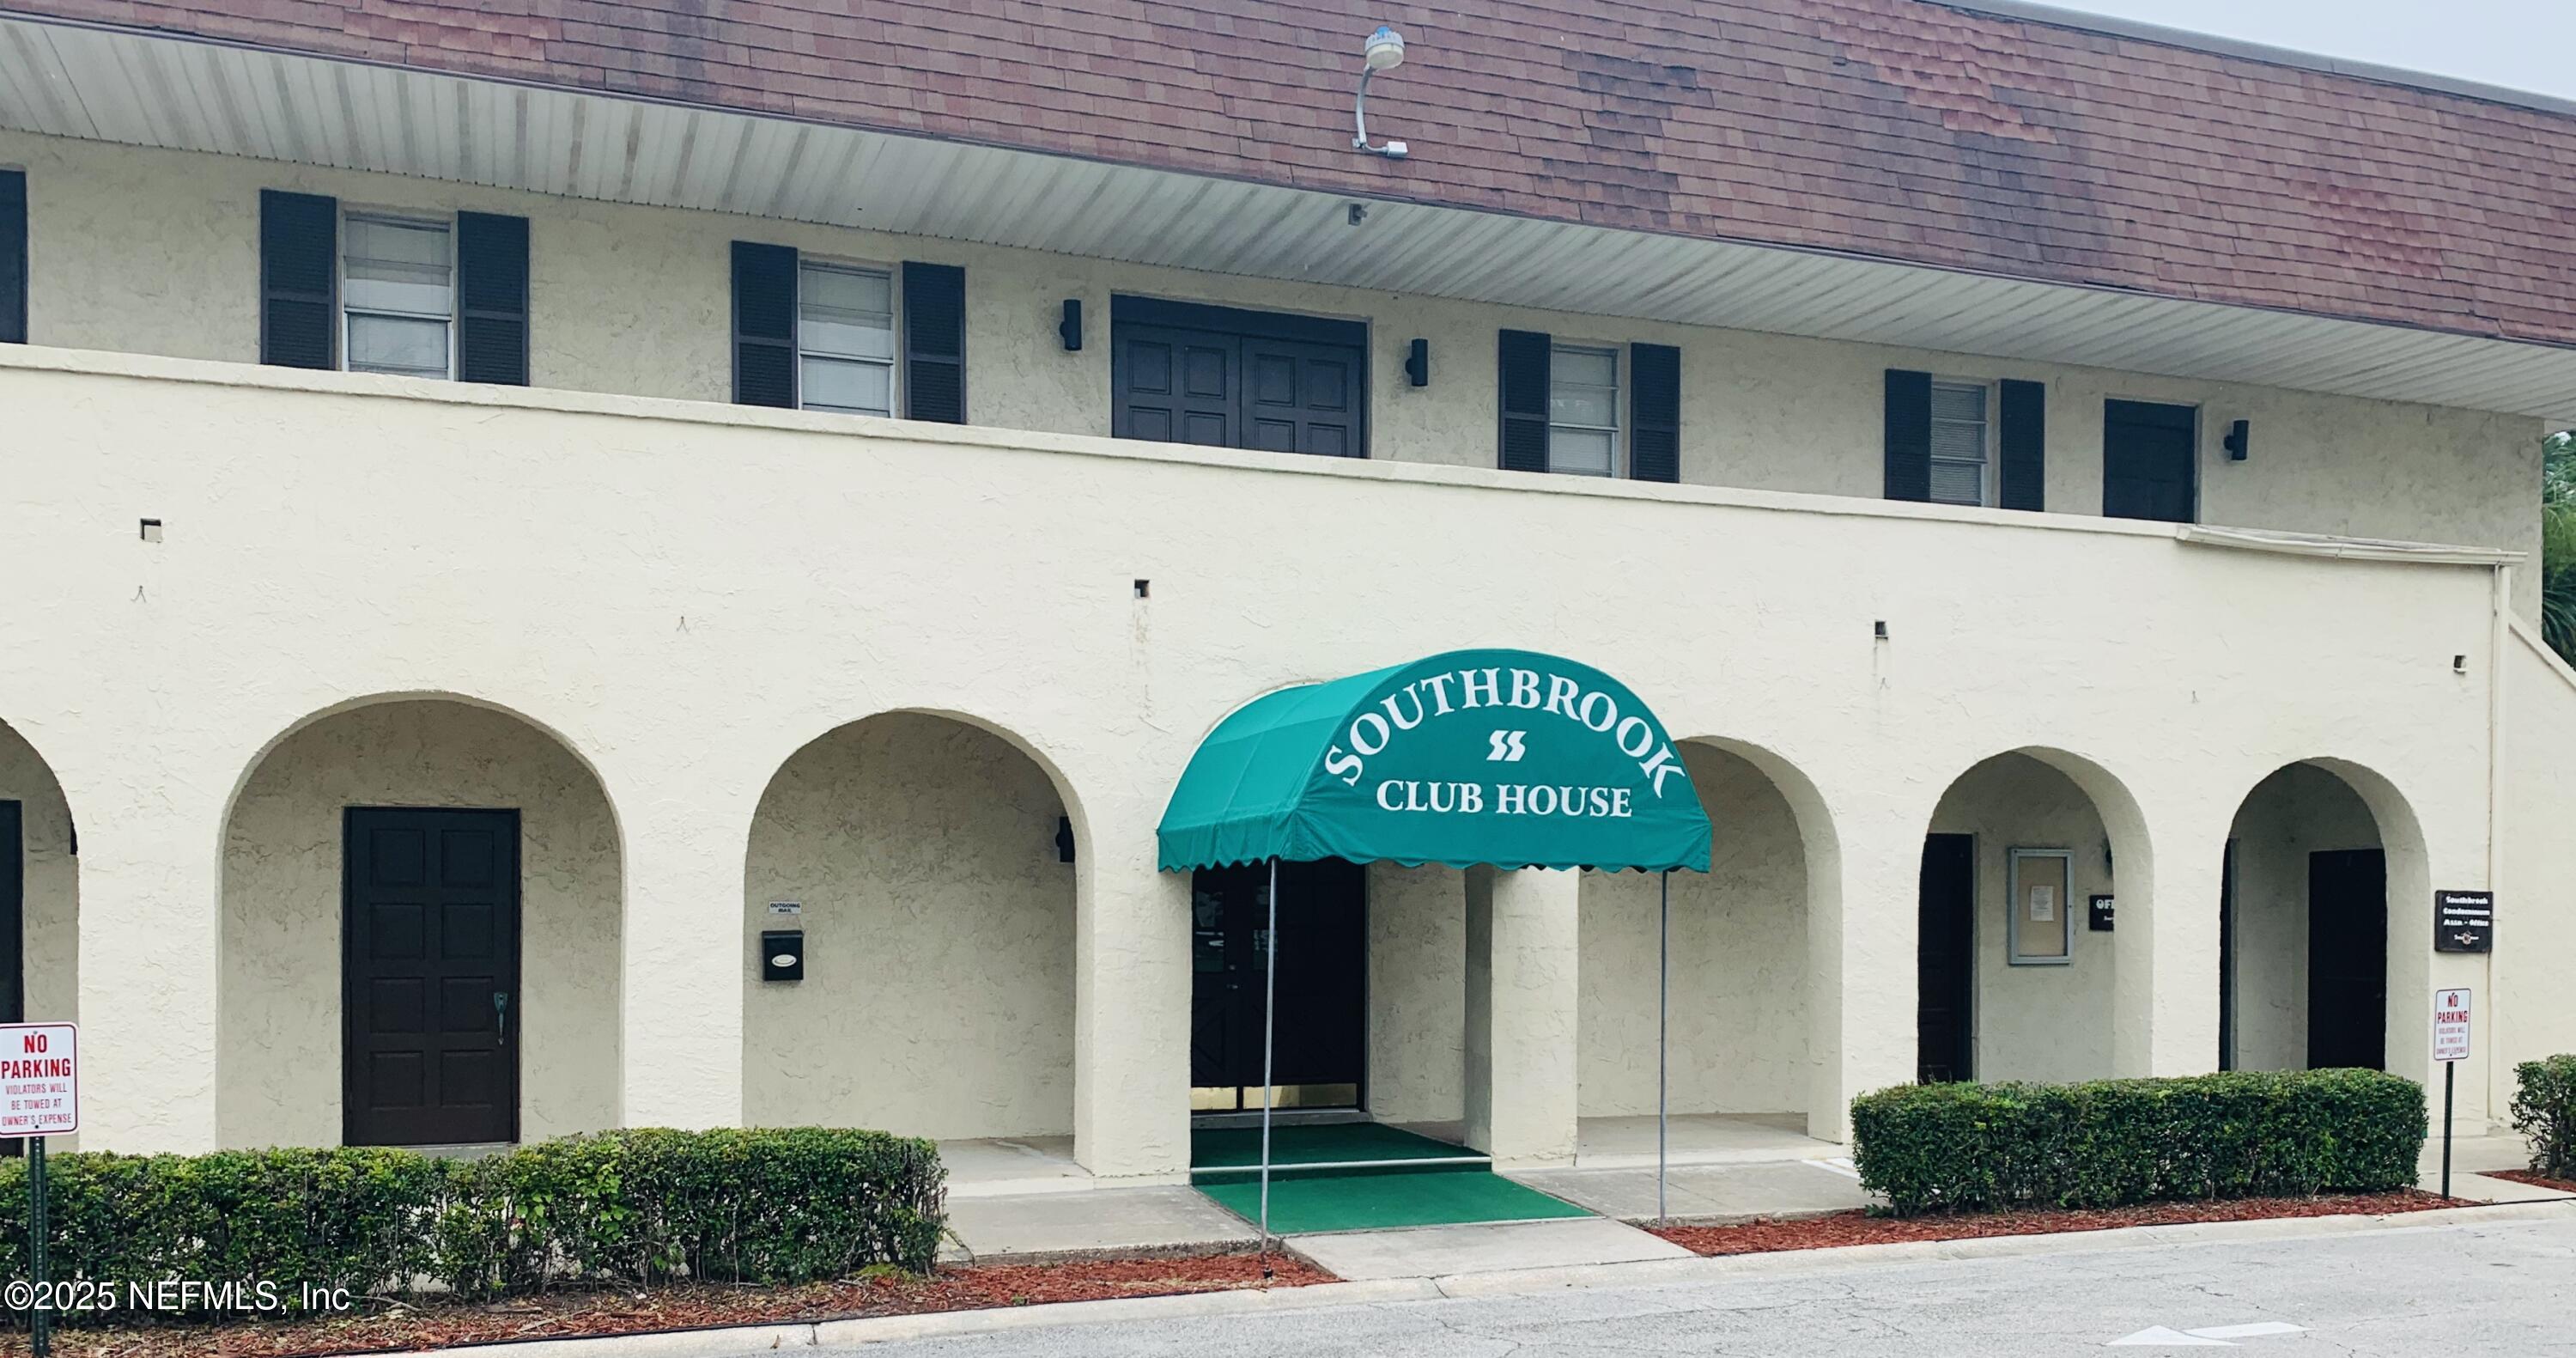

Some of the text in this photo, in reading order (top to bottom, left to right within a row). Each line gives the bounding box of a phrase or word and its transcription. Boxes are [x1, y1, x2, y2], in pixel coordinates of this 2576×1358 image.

[1325, 667, 1686, 799] SOUTHBROOK
[1376, 780, 1632, 818] CLUB HOUSE
[2447, 995, 2458, 1008] NO
[2438, 1010, 2468, 1024] PARKING
[24, 1034, 47, 1053] NO
[1, 1058, 71, 1079] PARKING
[5, 1082, 67, 1095] VIOLATORS WILL
[11, 1099, 62, 1110] BE TOWED AT
[2, 1113, 72, 1126] OWNER'S EXPENSE
